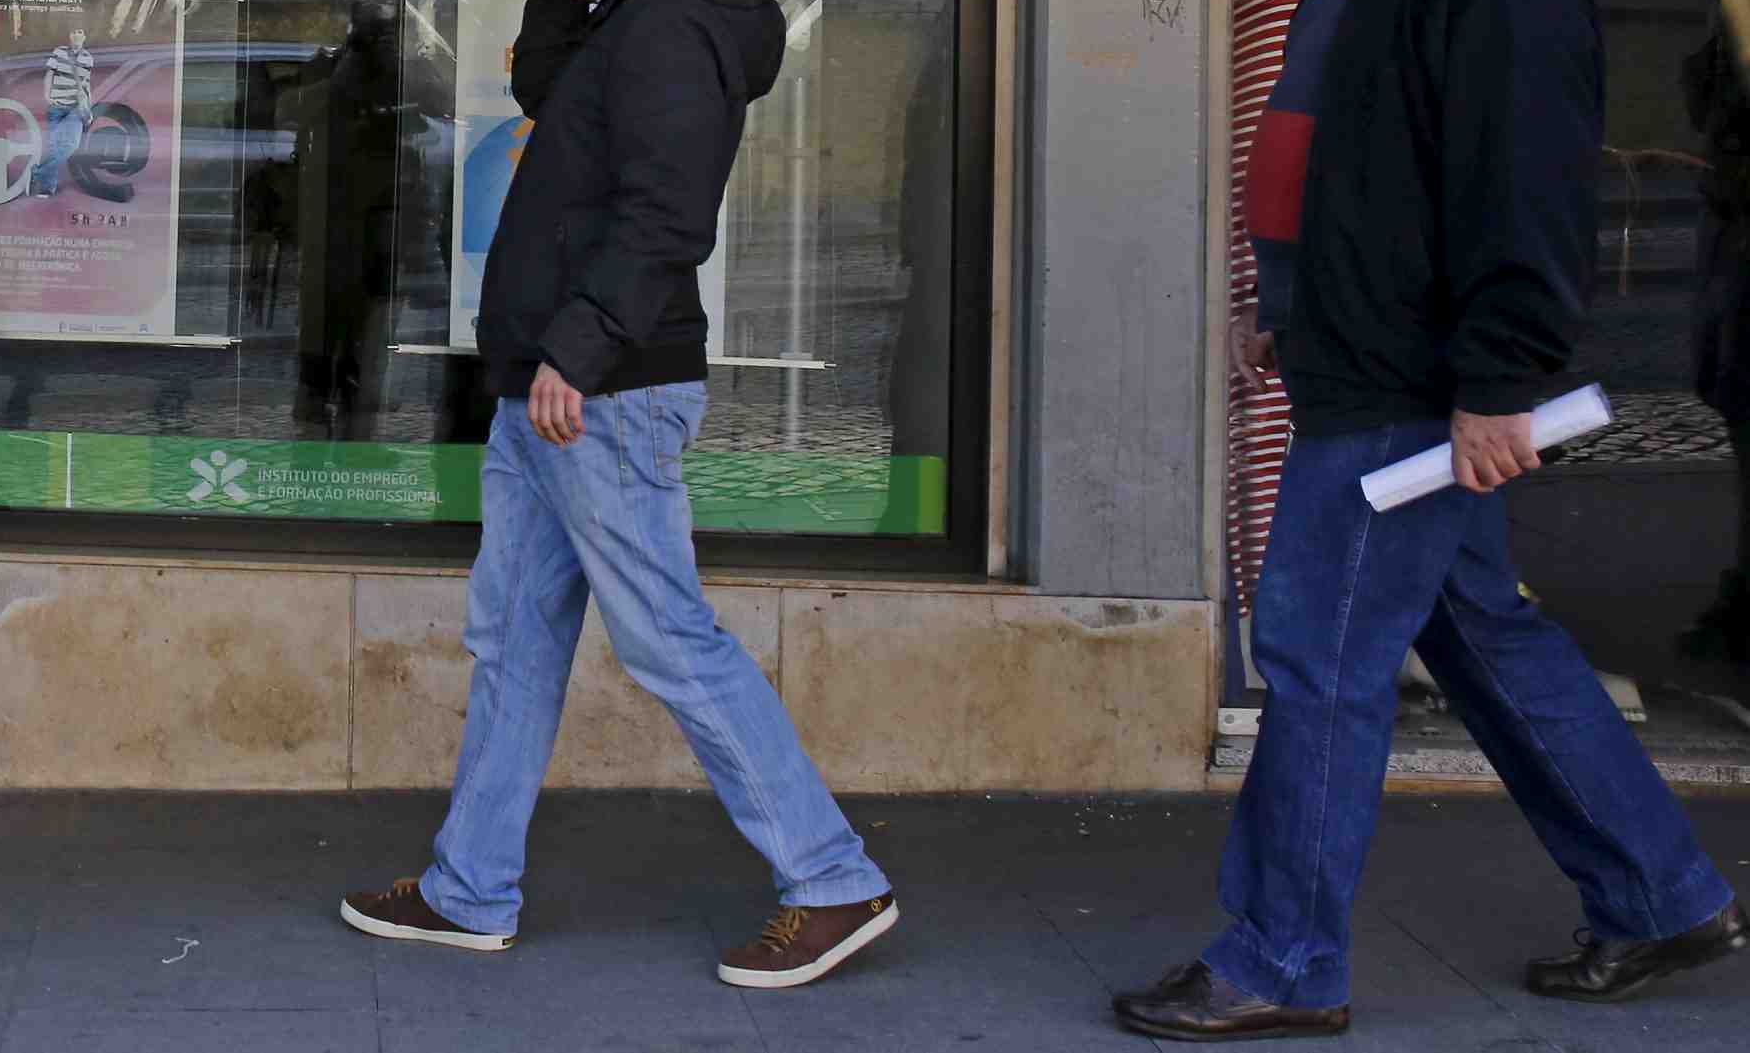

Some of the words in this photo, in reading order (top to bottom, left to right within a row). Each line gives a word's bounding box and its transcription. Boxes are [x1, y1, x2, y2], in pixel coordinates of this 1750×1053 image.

[258, 468, 328, 484] INSTITUTO
[331, 470, 350, 484] DO
[353, 471, 418, 486] EMPREGO
[257, 485, 266, 499] E
[268, 484, 344, 502] FORMAÇÃO
[346, 489, 443, 505] PROFISSIONAL
